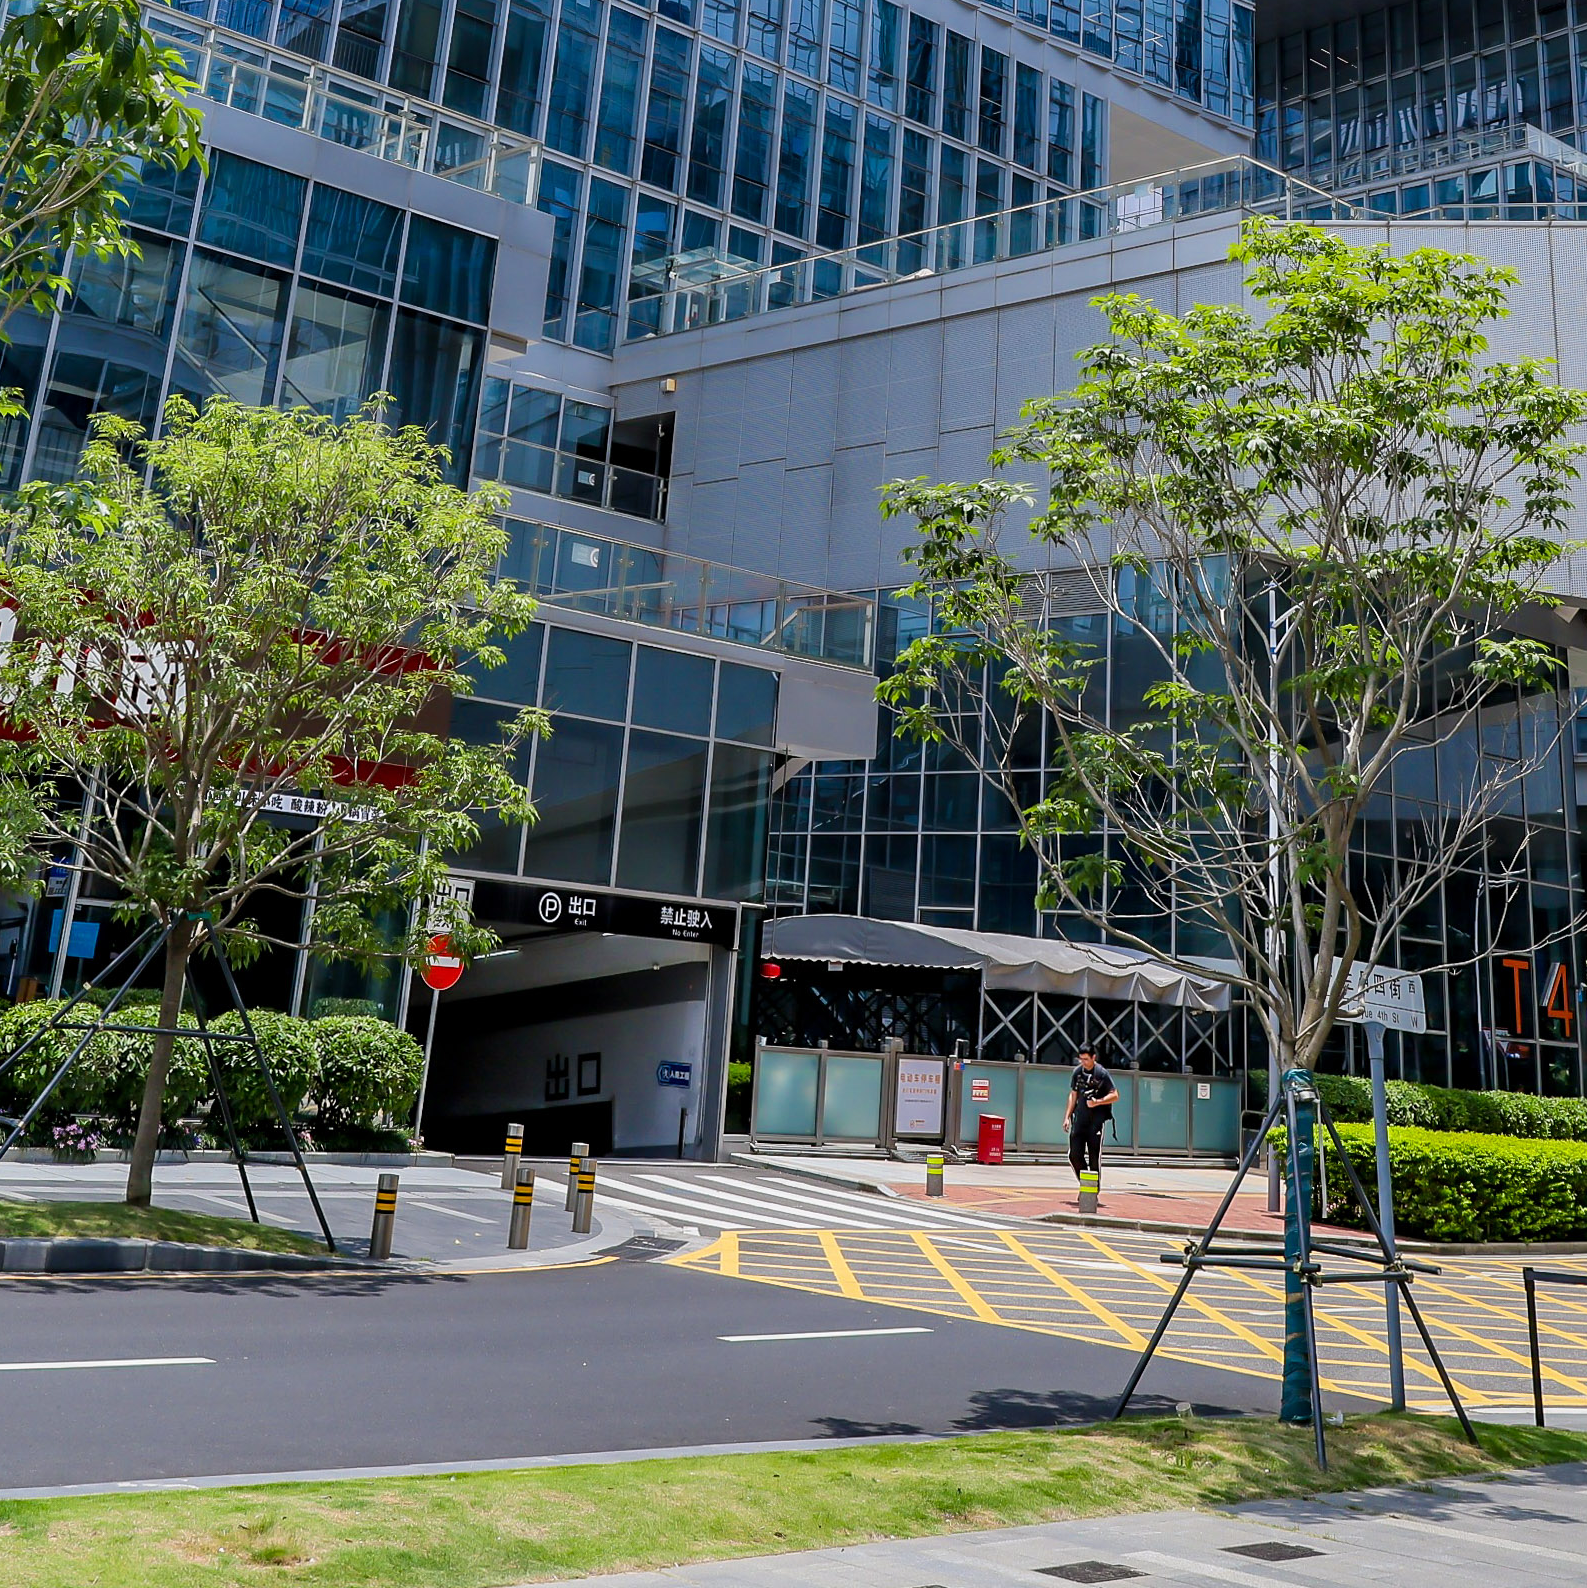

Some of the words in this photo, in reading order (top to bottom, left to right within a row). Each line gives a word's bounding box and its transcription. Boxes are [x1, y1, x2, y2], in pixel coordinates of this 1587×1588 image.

[290, 798, 328, 816] 酸辣粉
[568, 896, 596, 917] 出口
[574, 918, 587, 927] Exit
[660, 906, 713, 929] 禁止驶入
[672, 928, 681, 936] No
[683, 929, 699, 938] Enter
[1502, 958, 1573, 1037] T4
[1377, 1010, 1388, 1021] 4th
[1392, 1012, 1400, 1023] St
[1411, 1015, 1418, 1028] W
[544, 1052, 601, 1101] 出口
